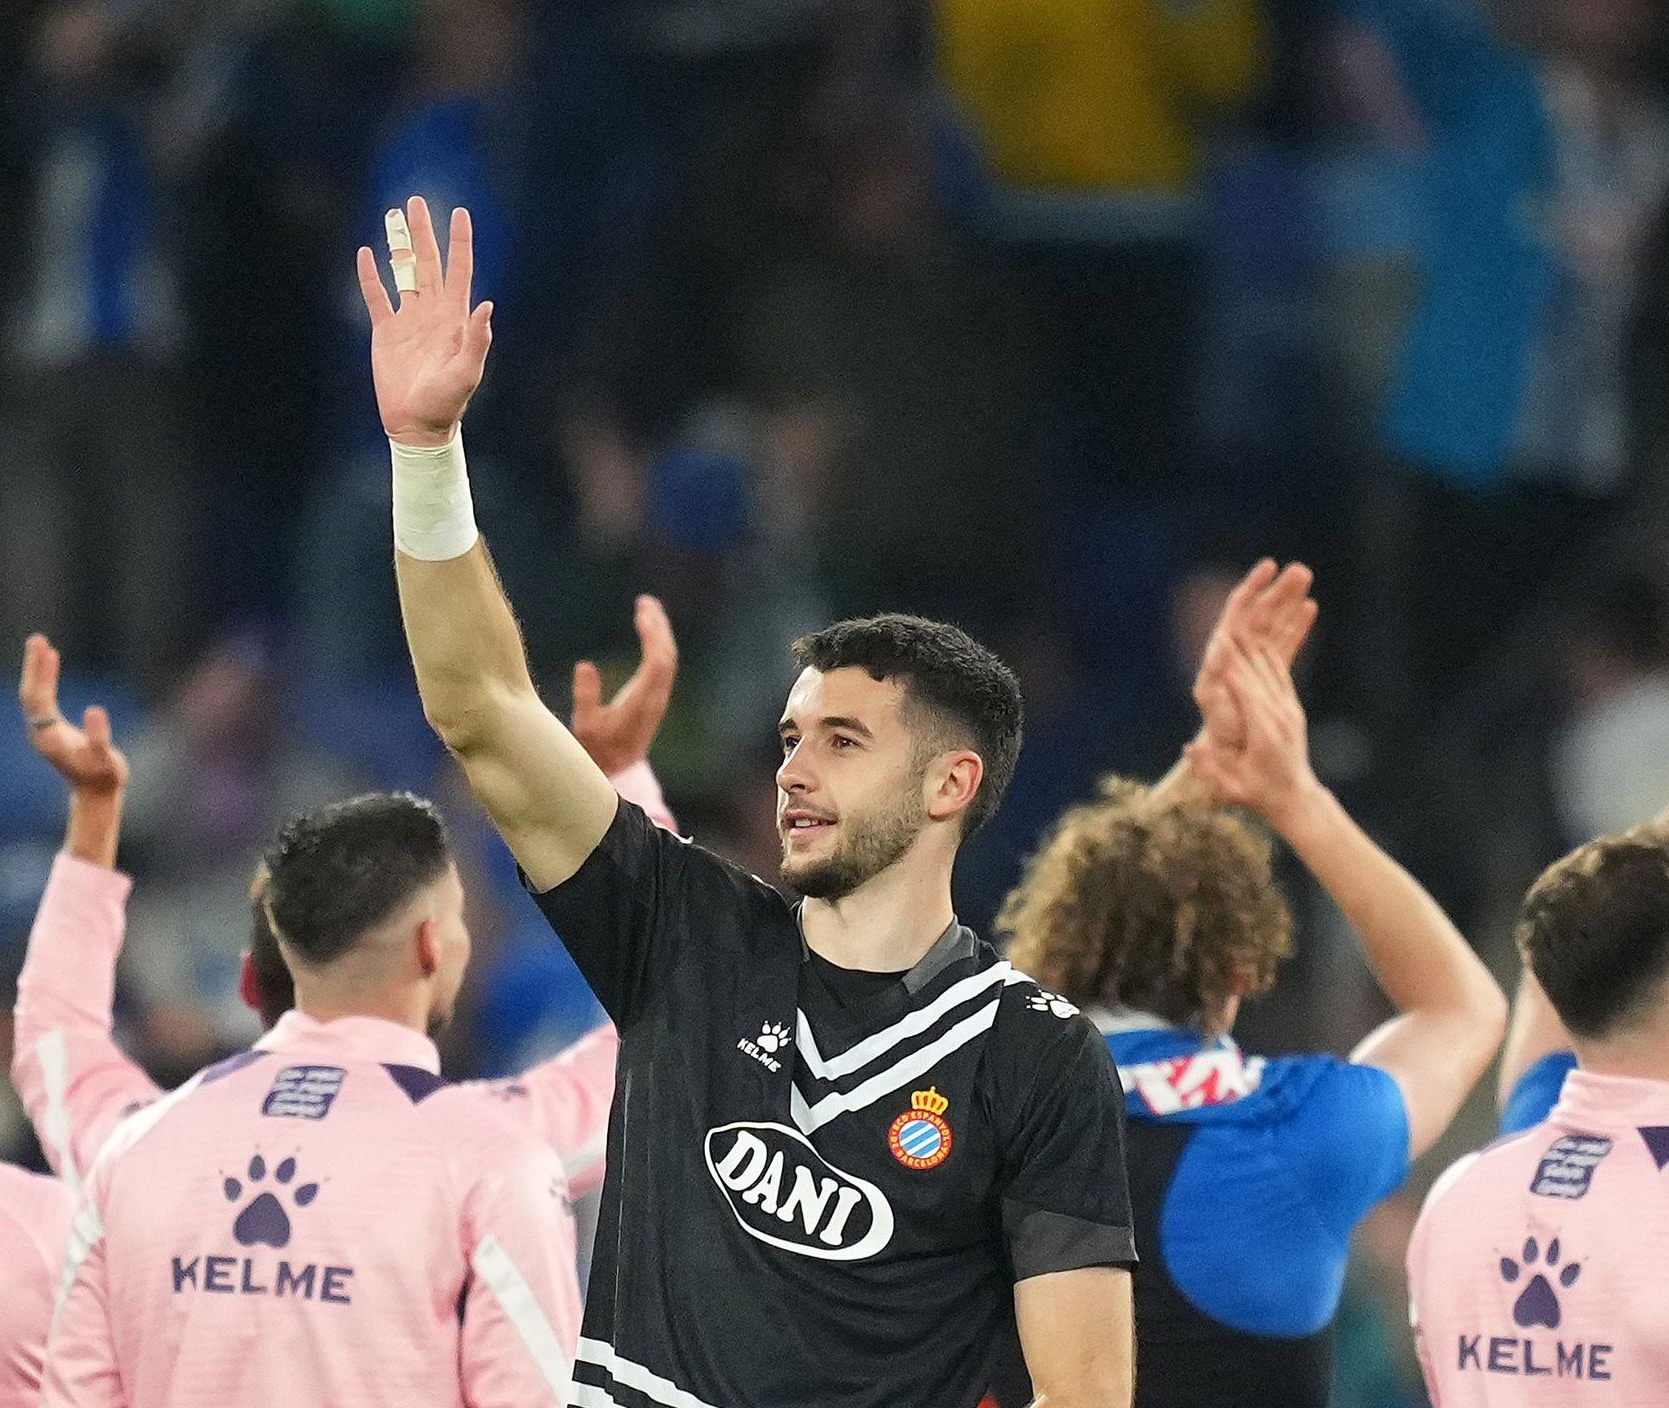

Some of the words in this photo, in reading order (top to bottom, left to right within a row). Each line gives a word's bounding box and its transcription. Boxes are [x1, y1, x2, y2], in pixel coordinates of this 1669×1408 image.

[737, 1038, 782, 1073] KELME
[716, 1130, 862, 1246] DANI
[171, 1255, 355, 1305] KELME
[1458, 1334, 1613, 1381] KELME
